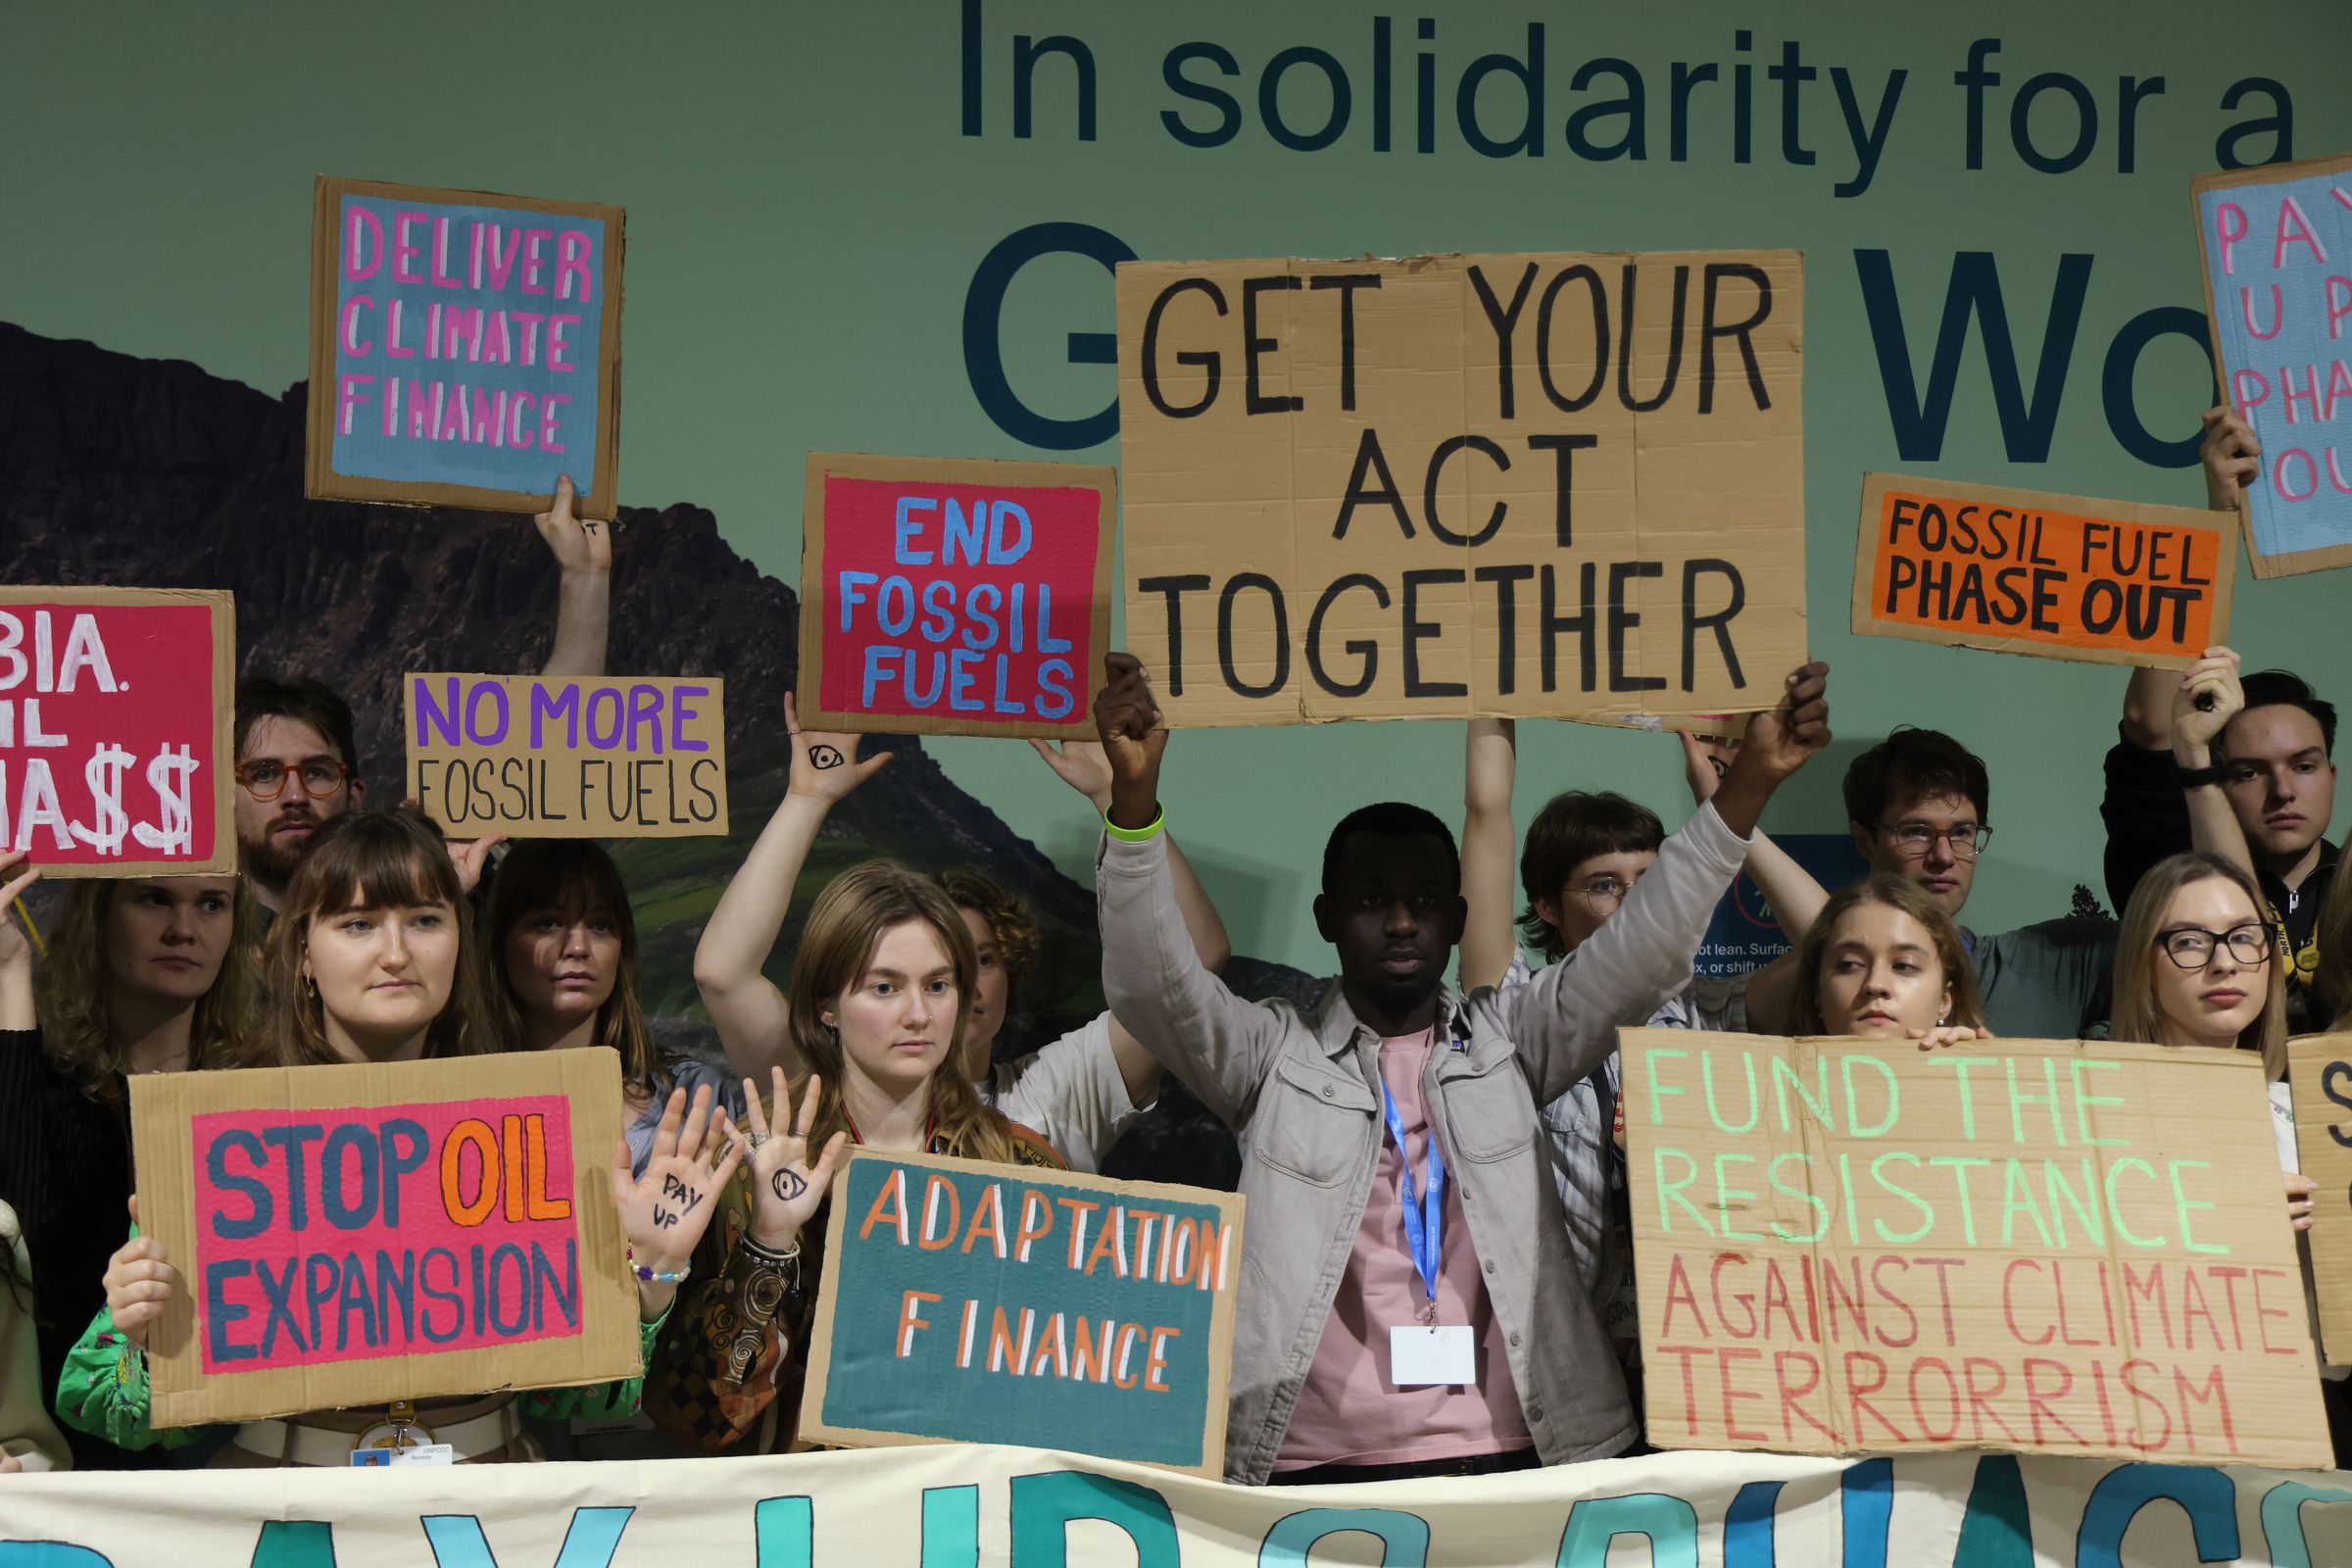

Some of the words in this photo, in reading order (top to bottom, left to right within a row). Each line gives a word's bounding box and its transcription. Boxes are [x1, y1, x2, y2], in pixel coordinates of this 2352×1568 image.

[961, 0, 1097, 141] In
[1159, 16, 1908, 198] solidarity
[1954, 38, 2165, 174] for
[2215, 75, 2294, 171] a
[345, 205, 592, 303] DELIVER
[339, 295, 581, 372] CLIMATE
[1142, 273, 1381, 418] GET
[1467, 262, 1772, 419] YOUR
[338, 373, 573, 454] FINANCE
[894, 496, 1032, 566] END
[1333, 429, 1598, 549] ACT
[1888, 499, 2056, 565] FOSSIL
[2081, 522, 2211, 586] FUEL
[839, 571, 1072, 654] FOSSIL
[1139, 558, 1746, 700] TOGETHER
[1886, 555, 2068, 634] PHASE
[2080, 578, 2203, 644] OUT
[414, 676, 510, 748] NO
[529, 683, 710, 755] MORE
[862, 645, 1074, 721] FUELS
[416, 759, 566, 823] FOSSIL
[580, 760, 718, 825] FUELS
[1694, 945, 1711, 956] ot
[1715, 943, 1746, 956] lean.
[1709, 963, 1724, 973] or
[1727, 960, 1755, 973] shift
[1645, 1049, 1900, 1138] FUND
[1929, 1055, 2131, 1147] THE
[207, 1118, 430, 1239] STOP
[440, 1113, 571, 1227] OIL
[654, 1203, 679, 1230] UP
[662, 1172, 703, 1217] PAY
[1654, 1147, 2231, 1254] RESISTANCE
[858, 1169, 1232, 1291] ADAPTATION
[204, 1238, 578, 1364] EXPANSION
[896, 1289, 1181, 1392] FINANCE
[1661, 1251, 1965, 1348] AGAINST
[2003, 1258, 2299, 1355] CLIMATE
[1657, 1344, 2240, 1454] TERRORRISM
